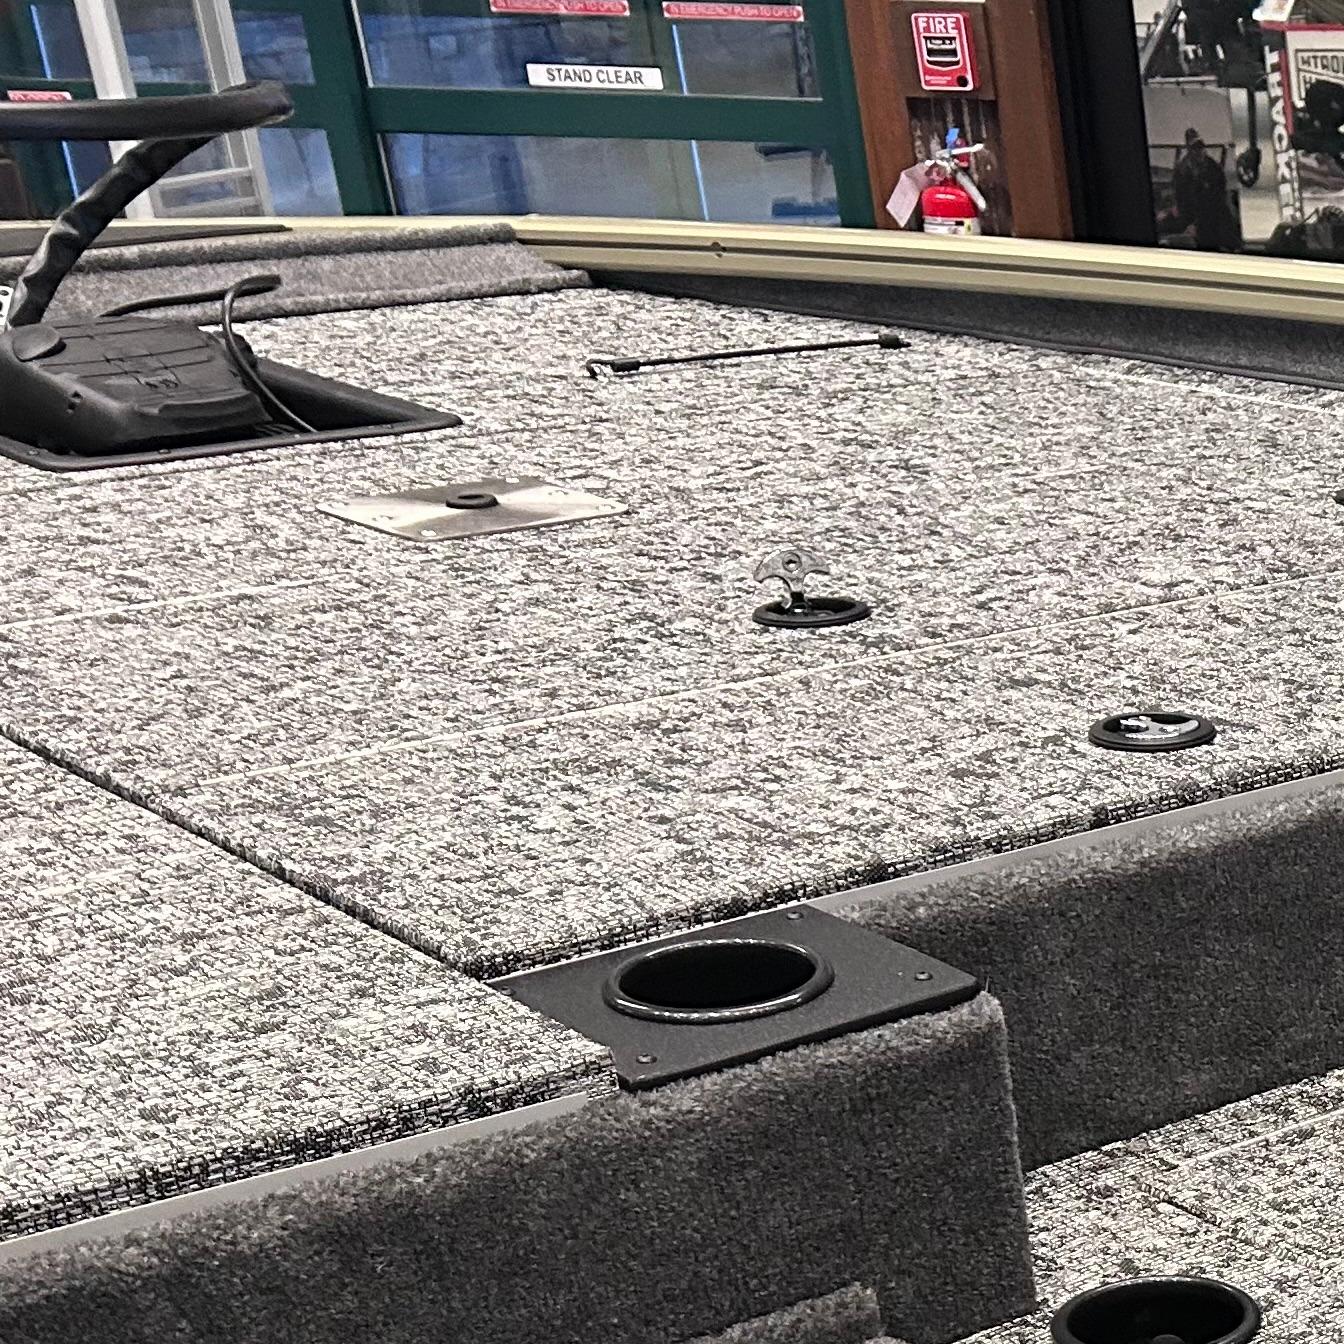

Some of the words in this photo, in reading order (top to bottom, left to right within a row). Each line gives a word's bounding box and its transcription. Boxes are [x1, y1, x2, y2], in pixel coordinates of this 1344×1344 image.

[918, 16, 958, 34] FIRE
[546, 67, 591, 83] STAND
[597, 69, 643, 85] CLEAR
